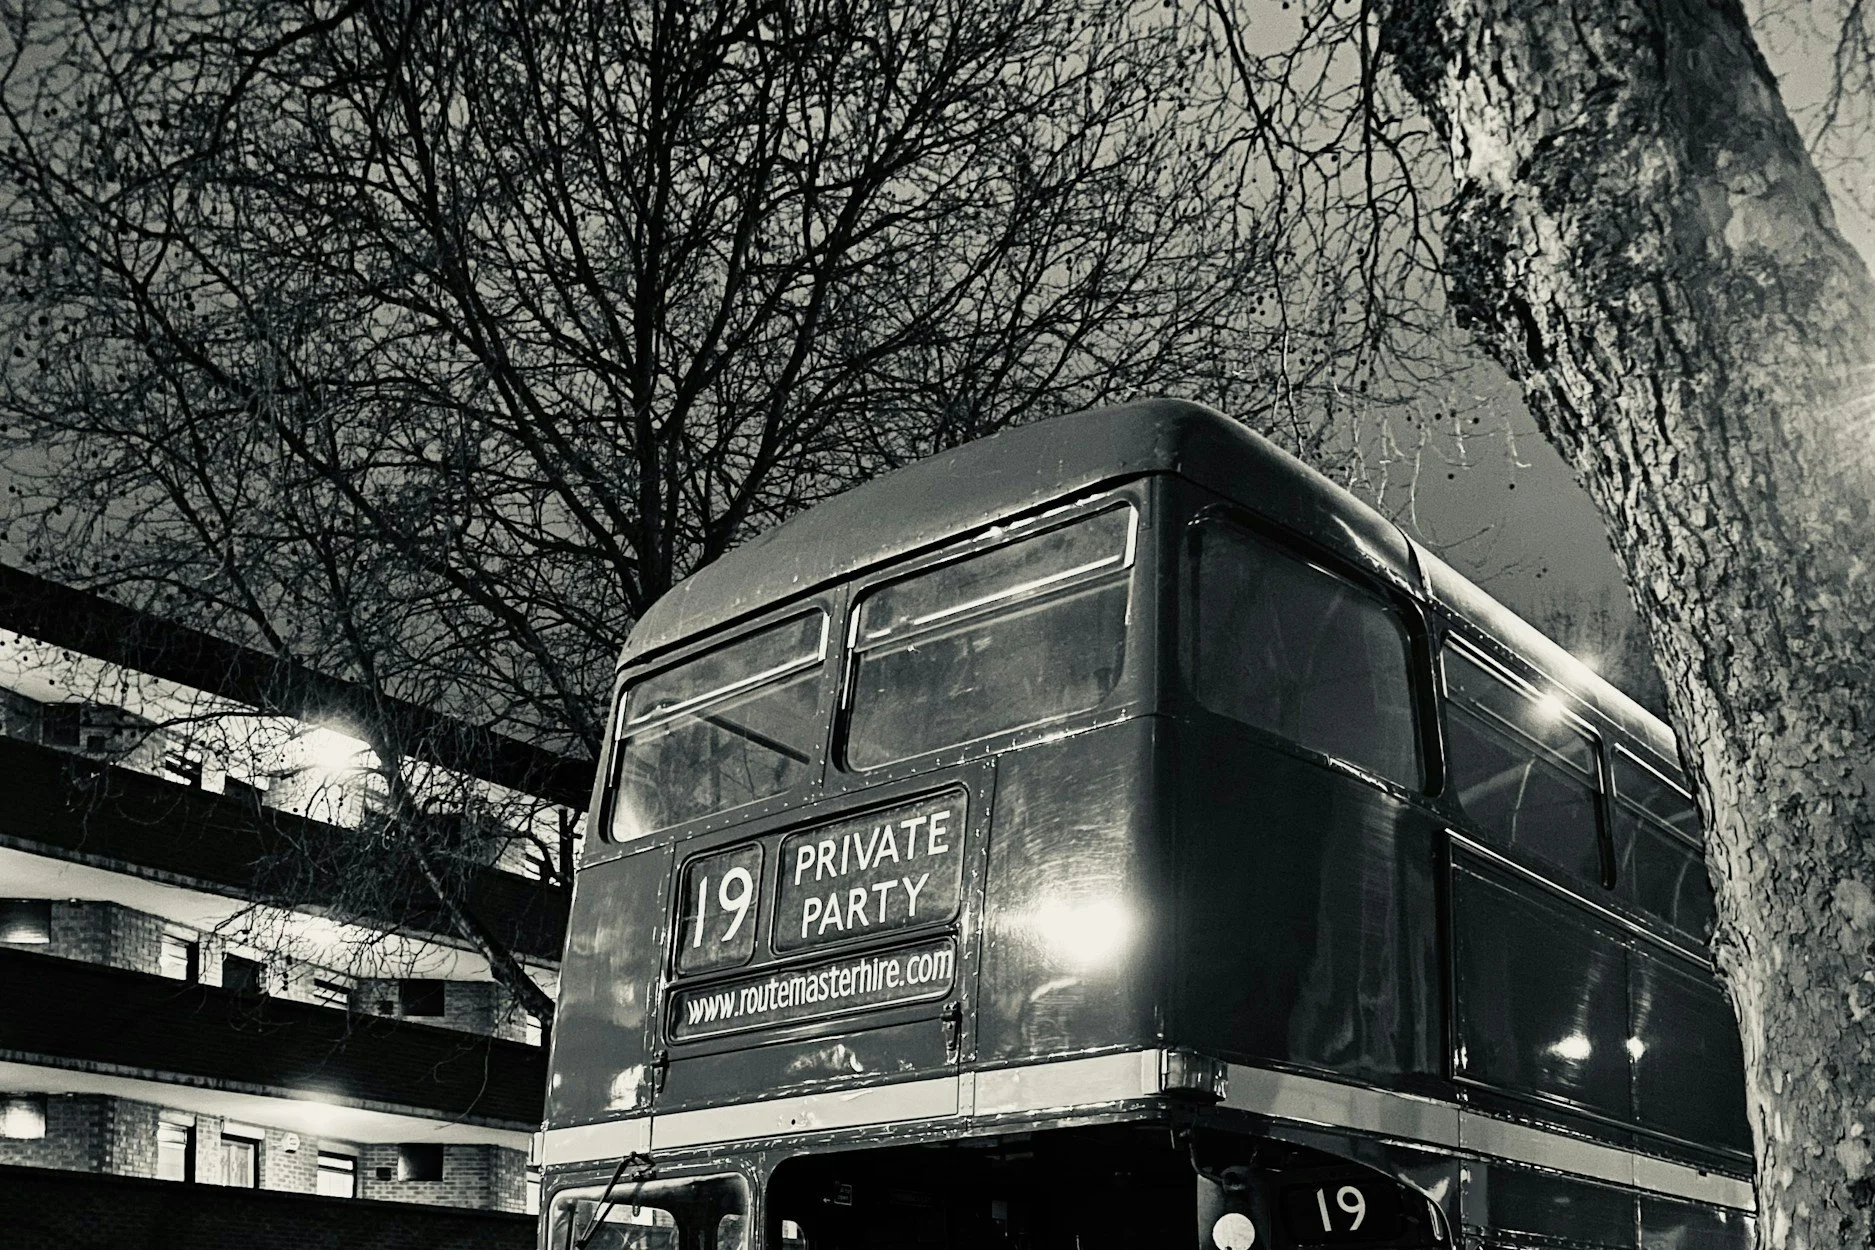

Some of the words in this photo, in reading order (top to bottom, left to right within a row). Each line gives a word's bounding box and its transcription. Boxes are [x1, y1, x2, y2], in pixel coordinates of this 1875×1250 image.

[794, 810, 950, 886] PRIVATE
[693, 866, 754, 948] 19
[801, 872, 929, 939] PARTY
[687, 949, 953, 1025] www.routemasterhire.com
[1316, 1185, 1366, 1232] 19
